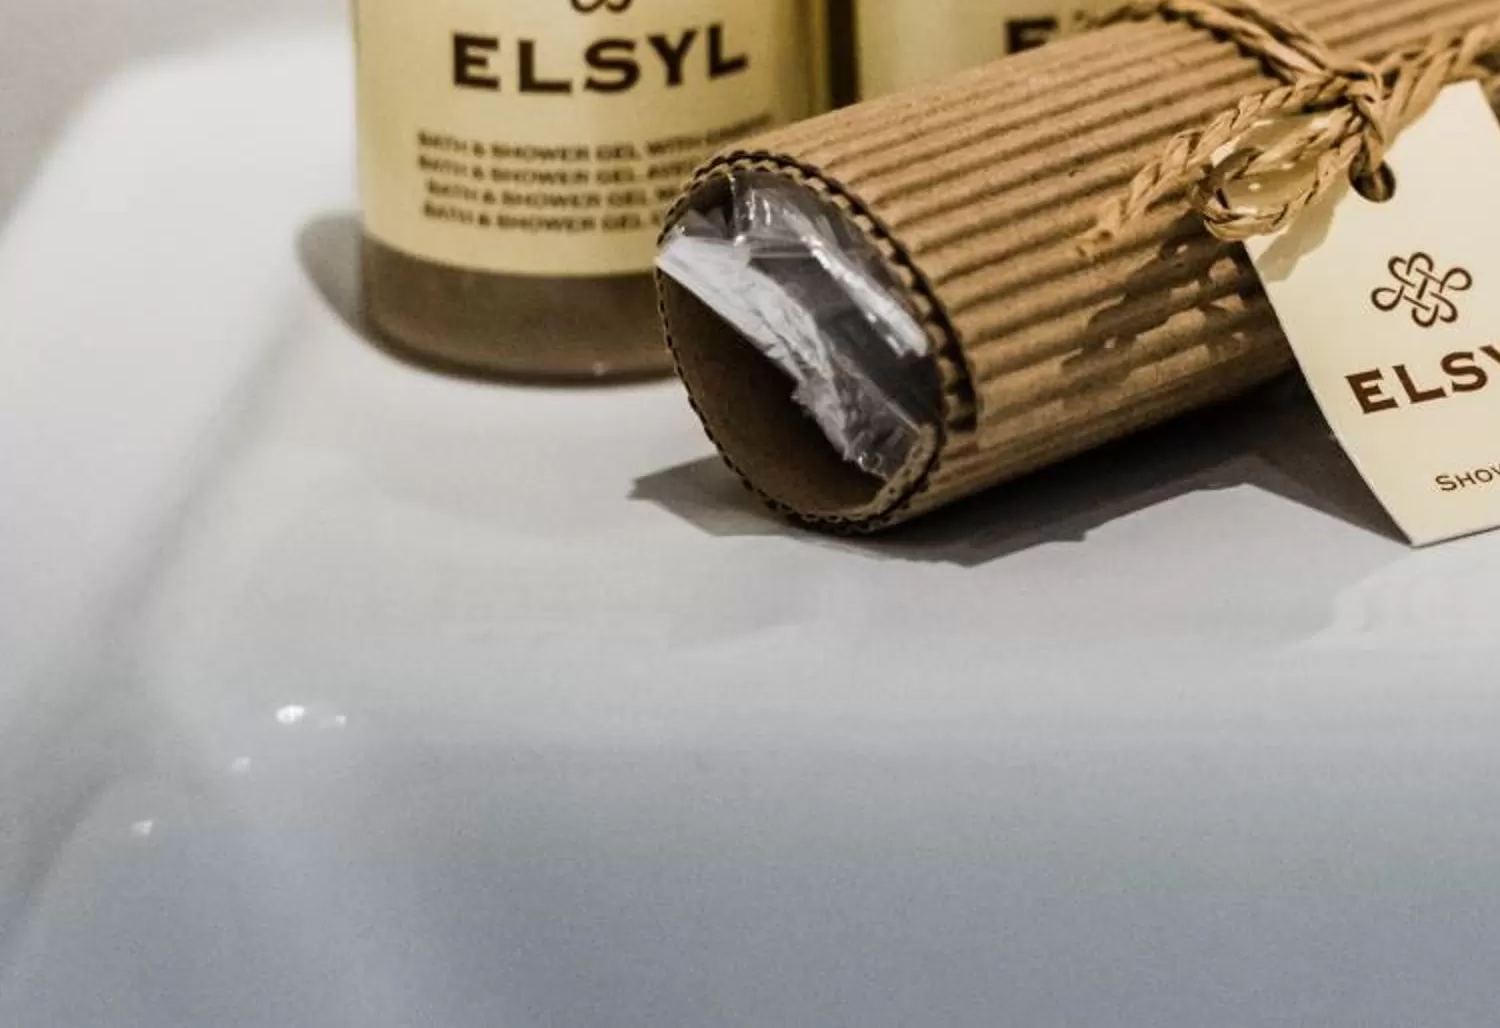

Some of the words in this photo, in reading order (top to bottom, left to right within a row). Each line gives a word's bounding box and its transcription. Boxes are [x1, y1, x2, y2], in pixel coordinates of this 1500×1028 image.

[451, 22, 748, 95] ELSYL
[491, 144, 590, 163] SHOWER
[597, 143, 642, 163] GEL
[491, 167, 590, 186] SHOWER
[597, 167, 641, 186] GEL
[502, 191, 601, 210] SHOWER
[607, 188, 648, 208] GEL
[497, 215, 597, 234] SHOWER
[602, 212, 643, 232] GEL
